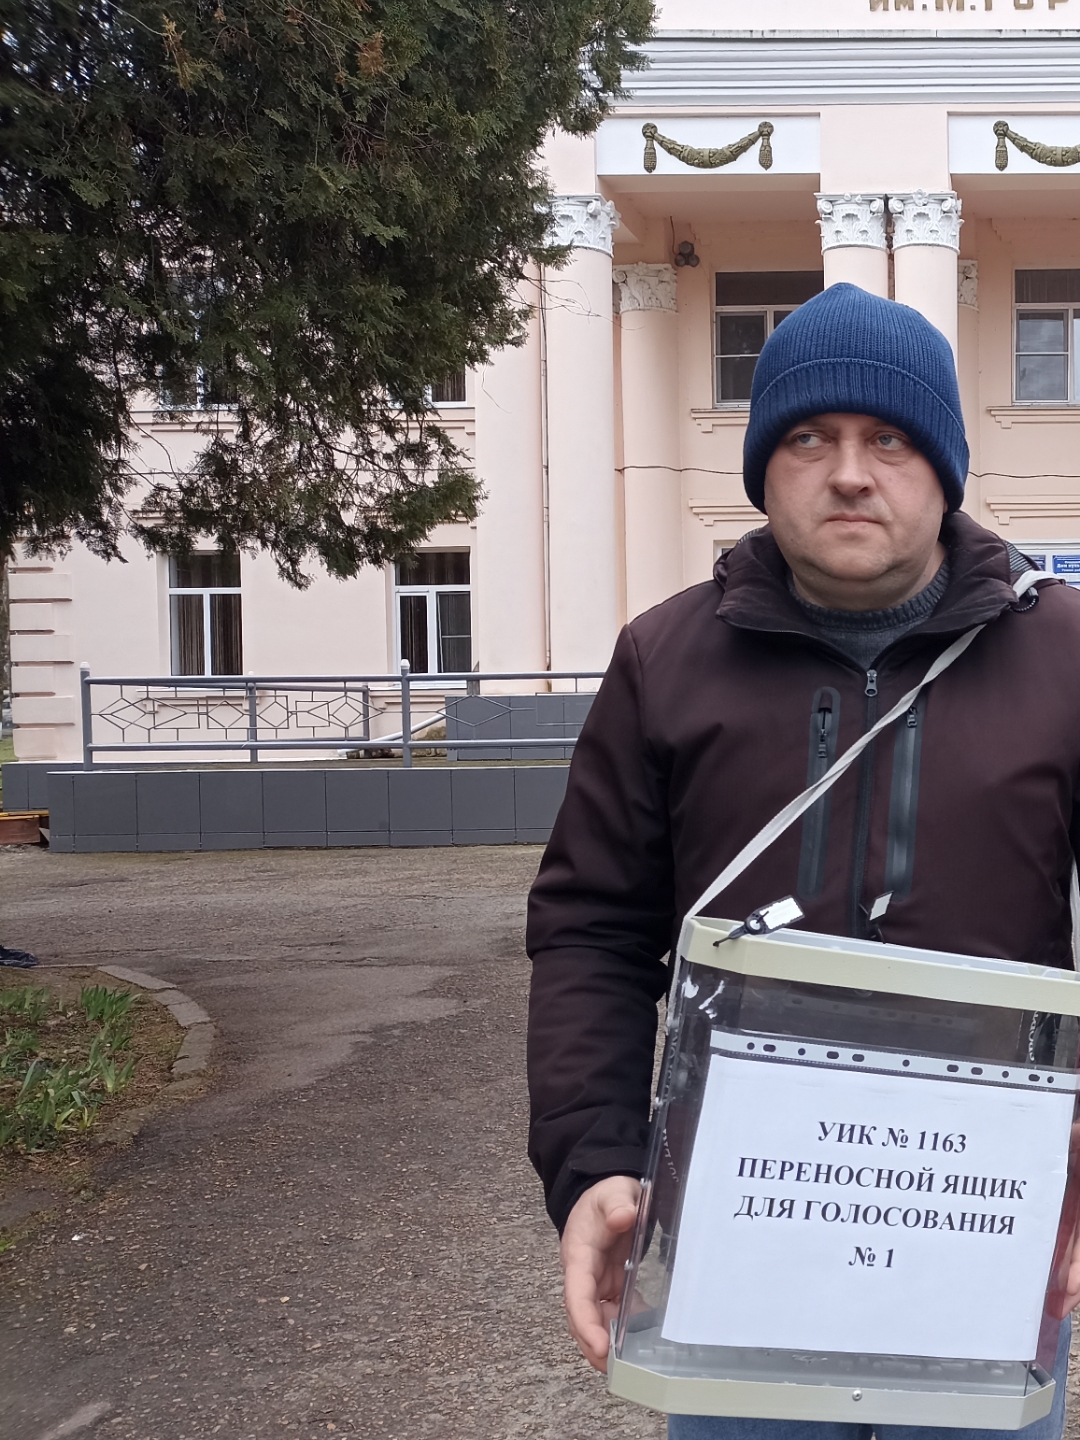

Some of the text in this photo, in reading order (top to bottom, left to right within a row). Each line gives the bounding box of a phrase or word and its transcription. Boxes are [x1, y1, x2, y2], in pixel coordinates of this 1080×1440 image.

[817, 1121, 967, 1153] УИК № 1163
[736, 1157, 1027, 1200] ПЕРЕНОСНОЙ ЯЩИК
[733, 1194, 1016, 1236] ДЛЯ ГОЛОСОВАНИЯ
[848, 1246, 894, 1268] № 1
